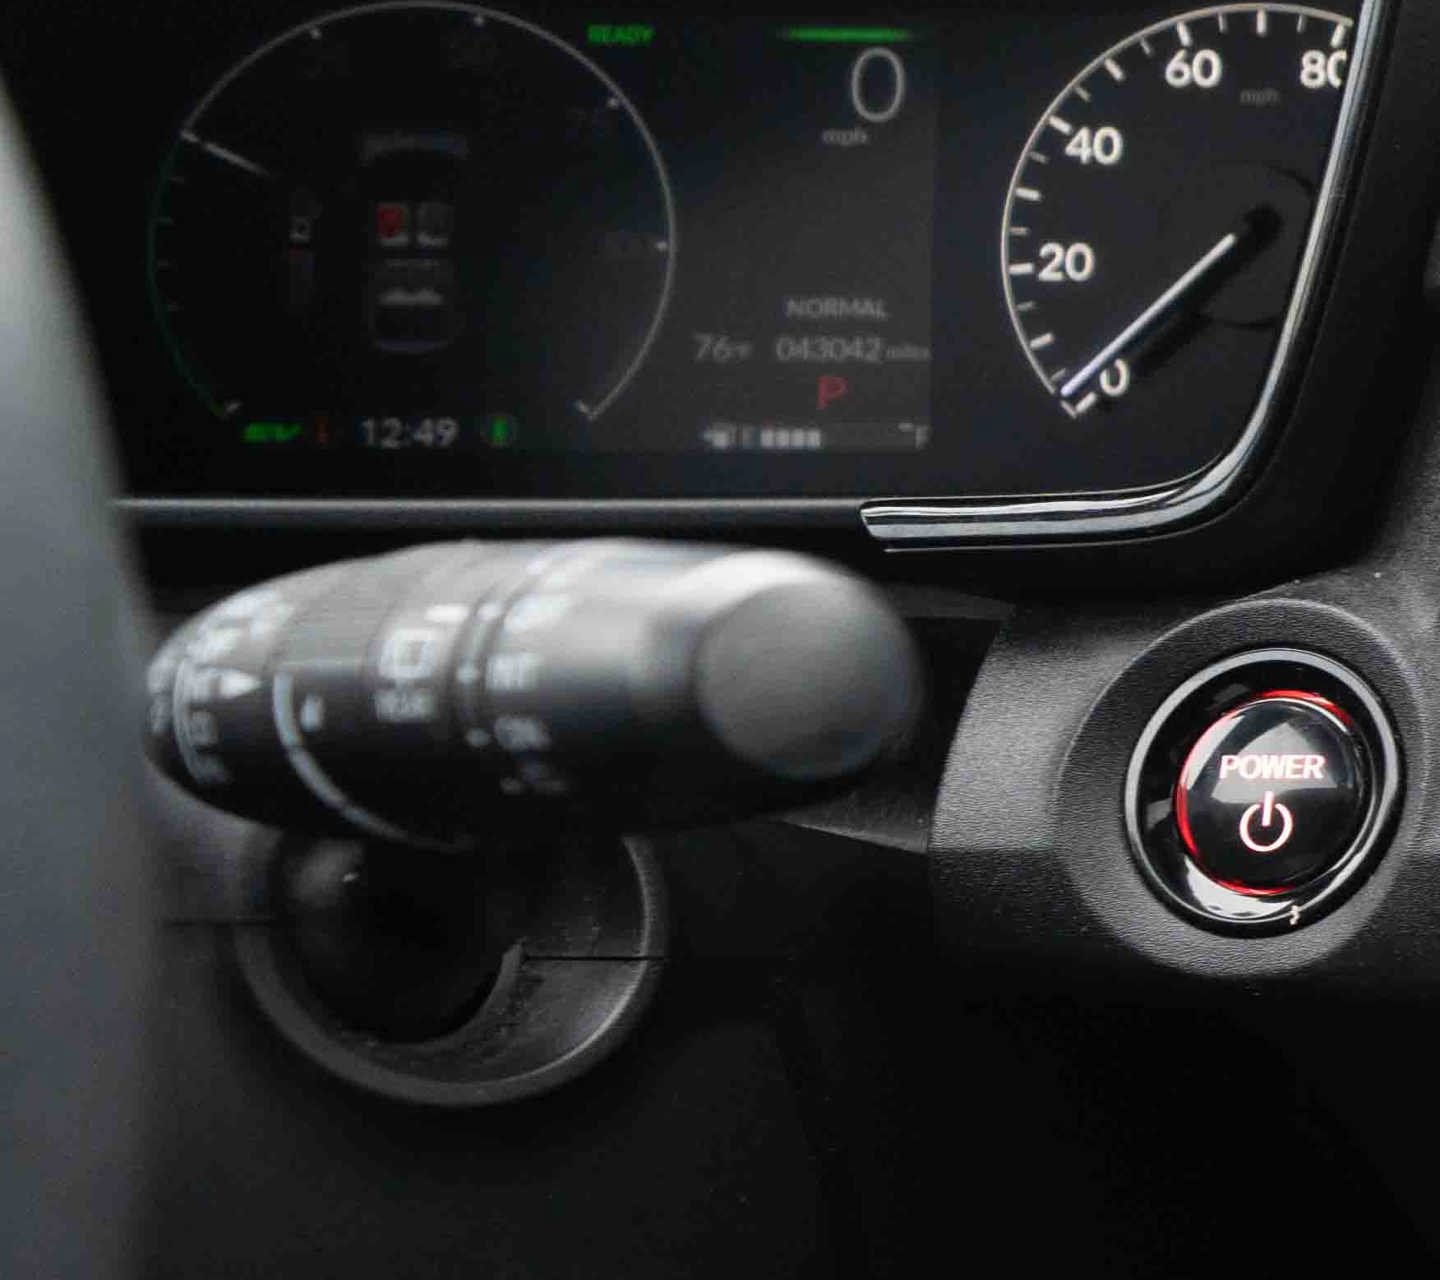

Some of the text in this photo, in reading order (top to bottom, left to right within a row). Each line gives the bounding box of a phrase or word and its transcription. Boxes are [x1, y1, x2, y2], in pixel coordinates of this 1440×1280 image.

[851, 47, 905, 123] 0
[1165, 49, 1222, 88] 60
[1067, 126, 1123, 163] 40
[1037, 242, 1094, 281] 20
[785, 297, 889, 320] NORMAL
[776, 335, 882, 363] 043042
[816, 374, 849, 410] P
[361, 417, 460, 448] 12:49
[1219, 754, 1327, 779] POWER
